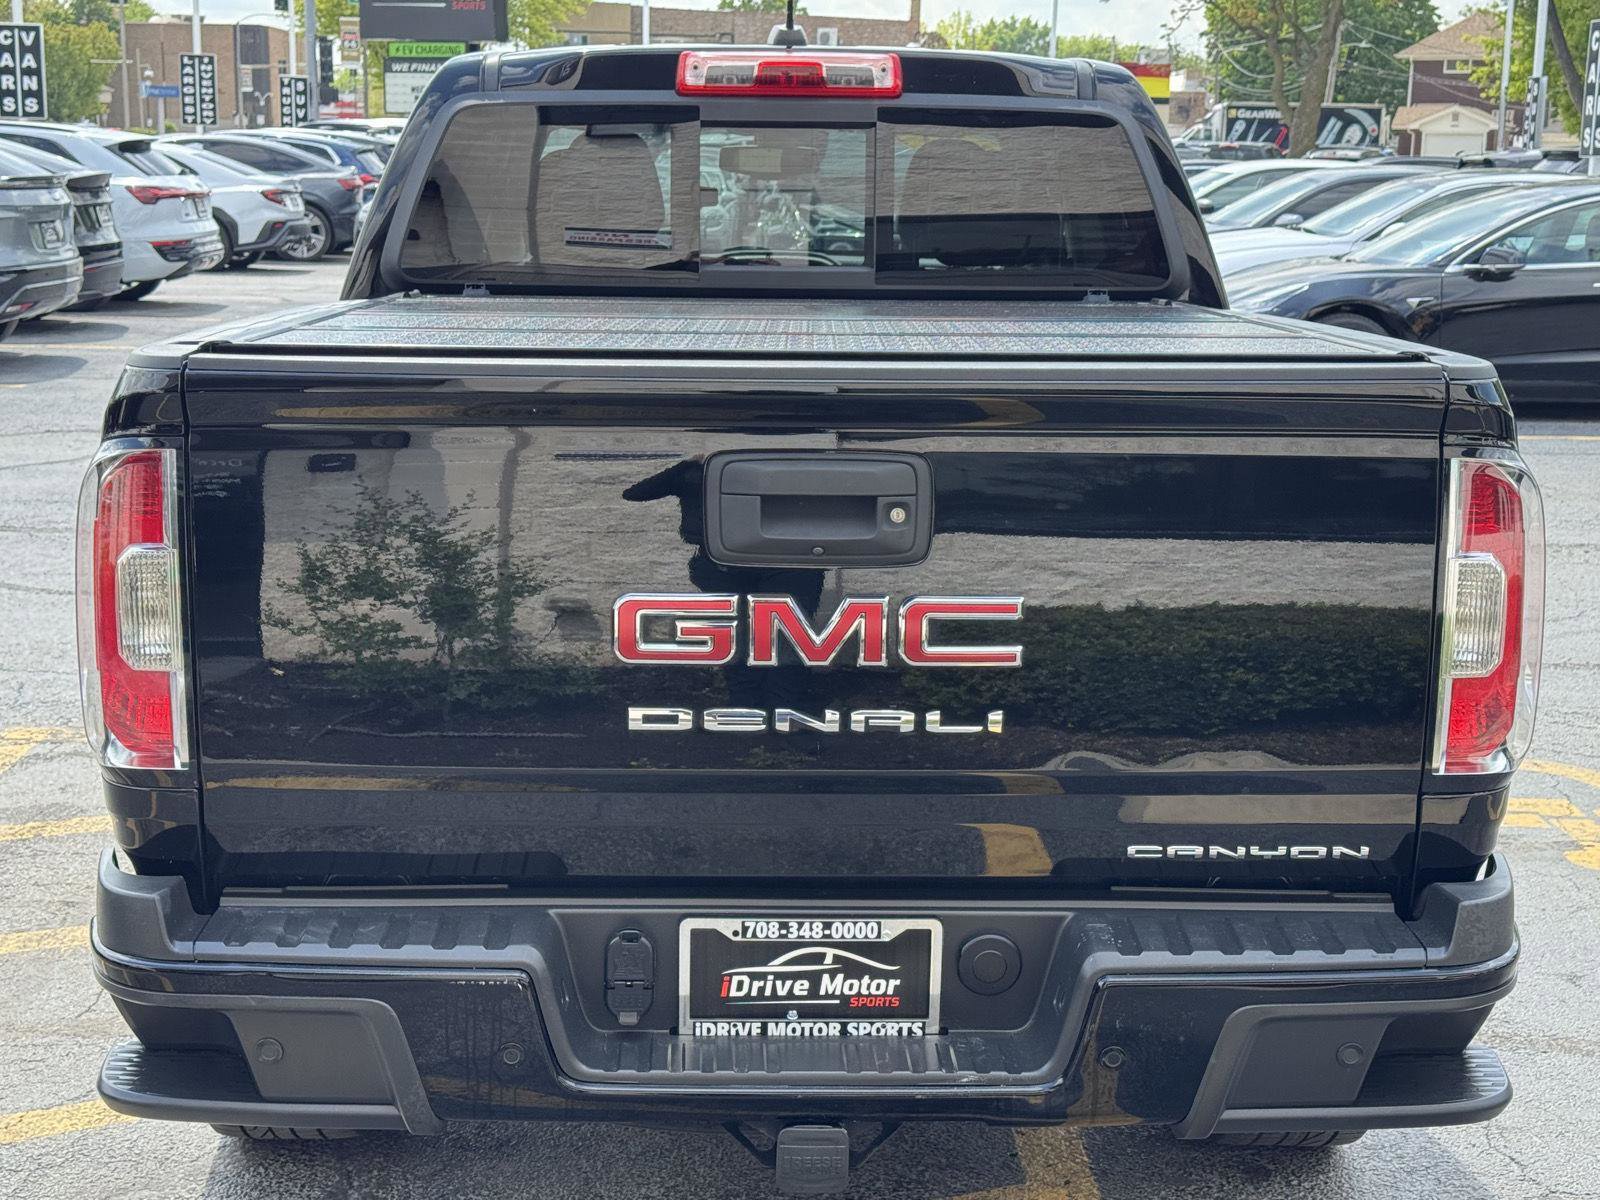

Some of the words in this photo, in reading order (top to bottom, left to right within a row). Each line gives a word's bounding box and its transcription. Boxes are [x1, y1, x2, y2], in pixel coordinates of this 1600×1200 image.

[451, 1, 486, 10] SPORTS
[402, 45, 414, 55] EV
[415, 45, 462, 55] CHARGING
[0, 29, 16, 113] CARS
[19, 30, 39, 113] VANS
[391, 62, 410, 72] WE
[182, 55, 195, 123] LARGEST
[200, 56, 215, 125] INVENTORY
[281, 77, 291, 127] TRUCK
[1583, 30, 1600, 148] CARS
[613, 593, 1024, 667] GMC
[628, 707, 1003, 734] DENALI
[1127, 845, 1370, 860] CANYON
[744, 921, 879, 939] 708-348-0000
[720, 974, 810, 998] iDrive
[820, 973, 901, 996] Motor
[849, 997, 900, 1007] SPORTS
[767, 1022, 841, 1036] MOTOR
[846, 1022, 923, 1036] SPORTS
